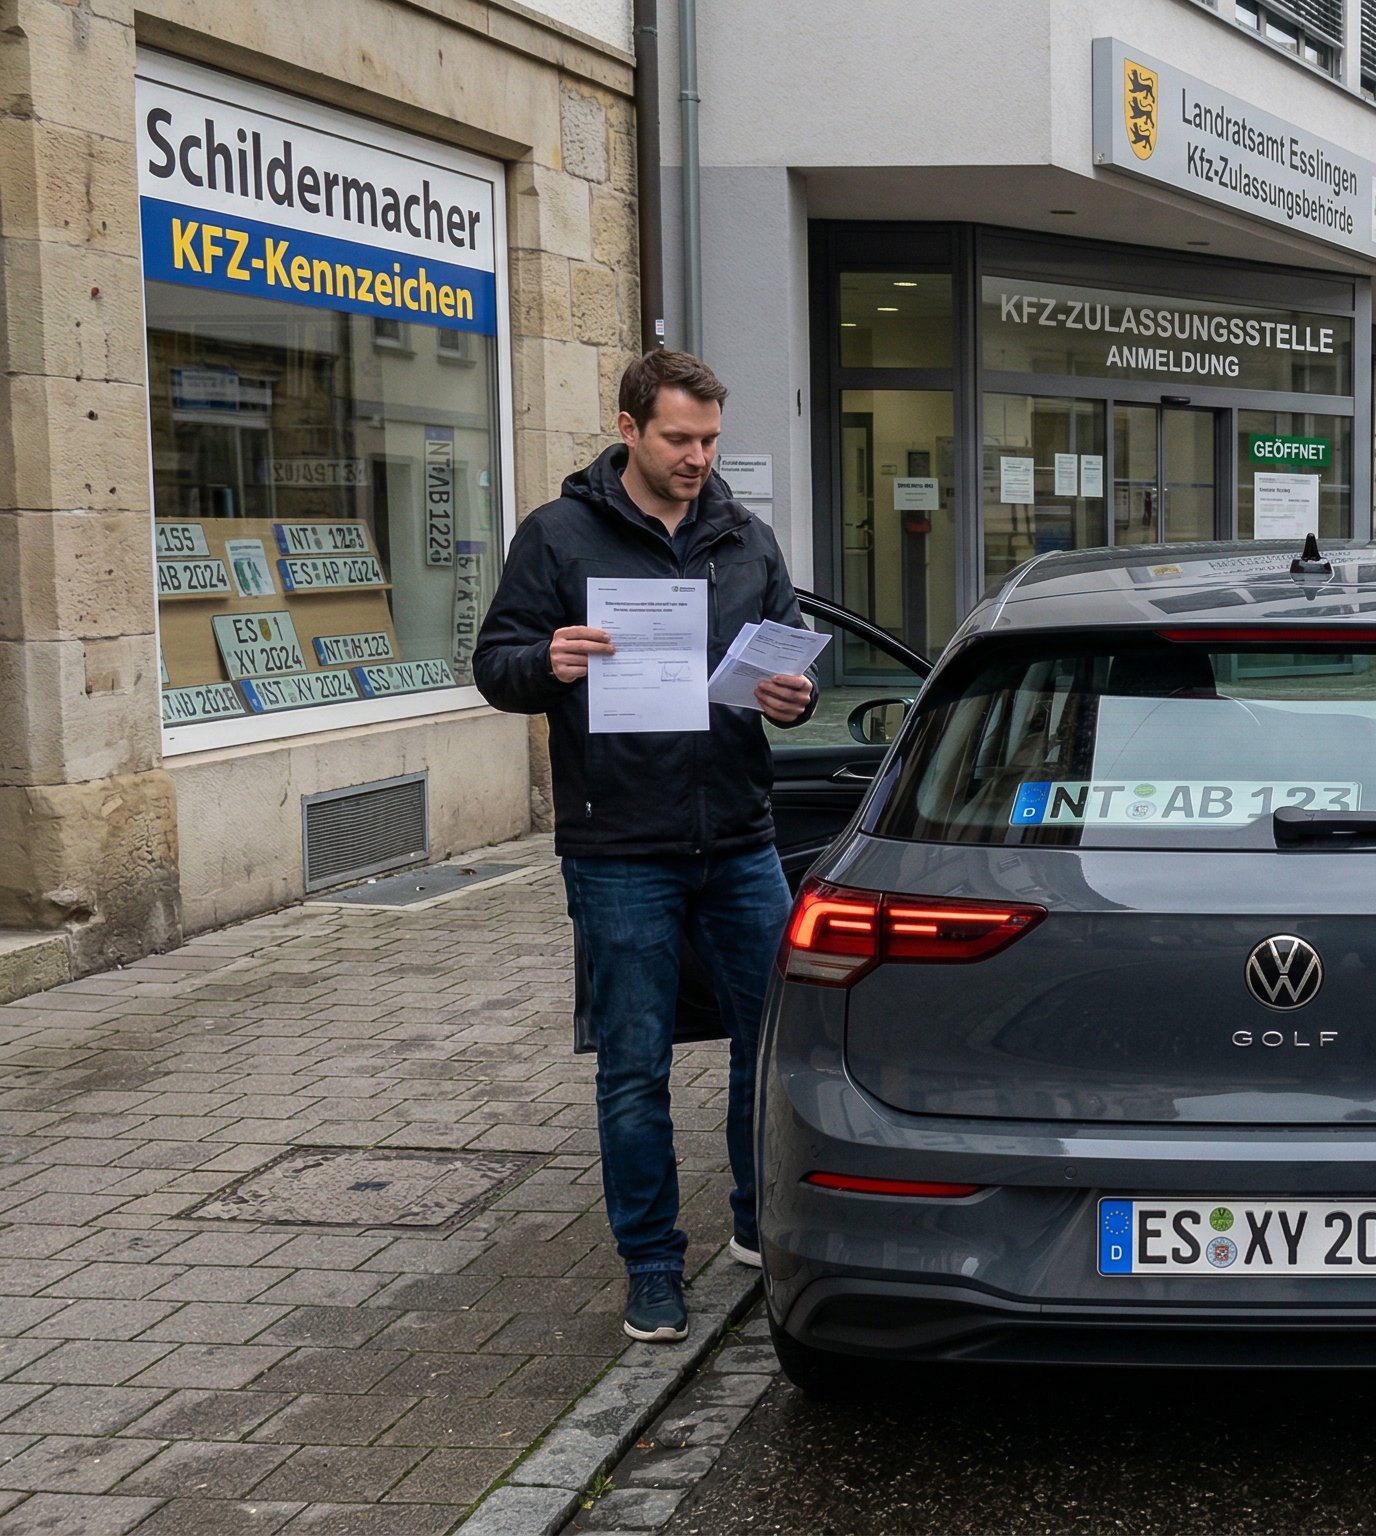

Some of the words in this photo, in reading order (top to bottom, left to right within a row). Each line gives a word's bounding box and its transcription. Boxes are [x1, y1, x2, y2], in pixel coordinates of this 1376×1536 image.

[1182, 88, 1285, 166] Landratsamt
[1289, 136, 1357, 197] Esslingen
[147, 107, 481, 250] Schildermacher
[1187, 142, 1353, 235] Kfz-Zulassungsbehörde
[171, 218, 474, 321] KFZ-Kennzeichen
[1000, 294, 1335, 354] KFZ-ZULASSUNGSSTELLE
[1106, 345, 1240, 378] ANMELDUNG
[1253, 438, 1326, 460] GEÖFFNET
[289, 527, 312, 550] NT
[183, 563, 228, 590] 2024
[289, 562, 314, 585] ES
[232, 618, 258, 644] ES
[234, 650, 259, 675] XY
[261, 644, 303, 672] 2024
[323, 639, 346, 662] NT
[364, 635, 390, 658] 123
[315, 672, 354, 698] 2024
[367, 668, 391, 692] SS
[1050, 786, 1125, 818] NT
[1161, 786, 1233, 818] AB
[1232, 1030, 1338, 1047] GOLF
[1111, 1245, 1122, 1260] D
[1138, 1210, 1201, 1265] ES
[1244, 1210, 1308, 1265] XY
